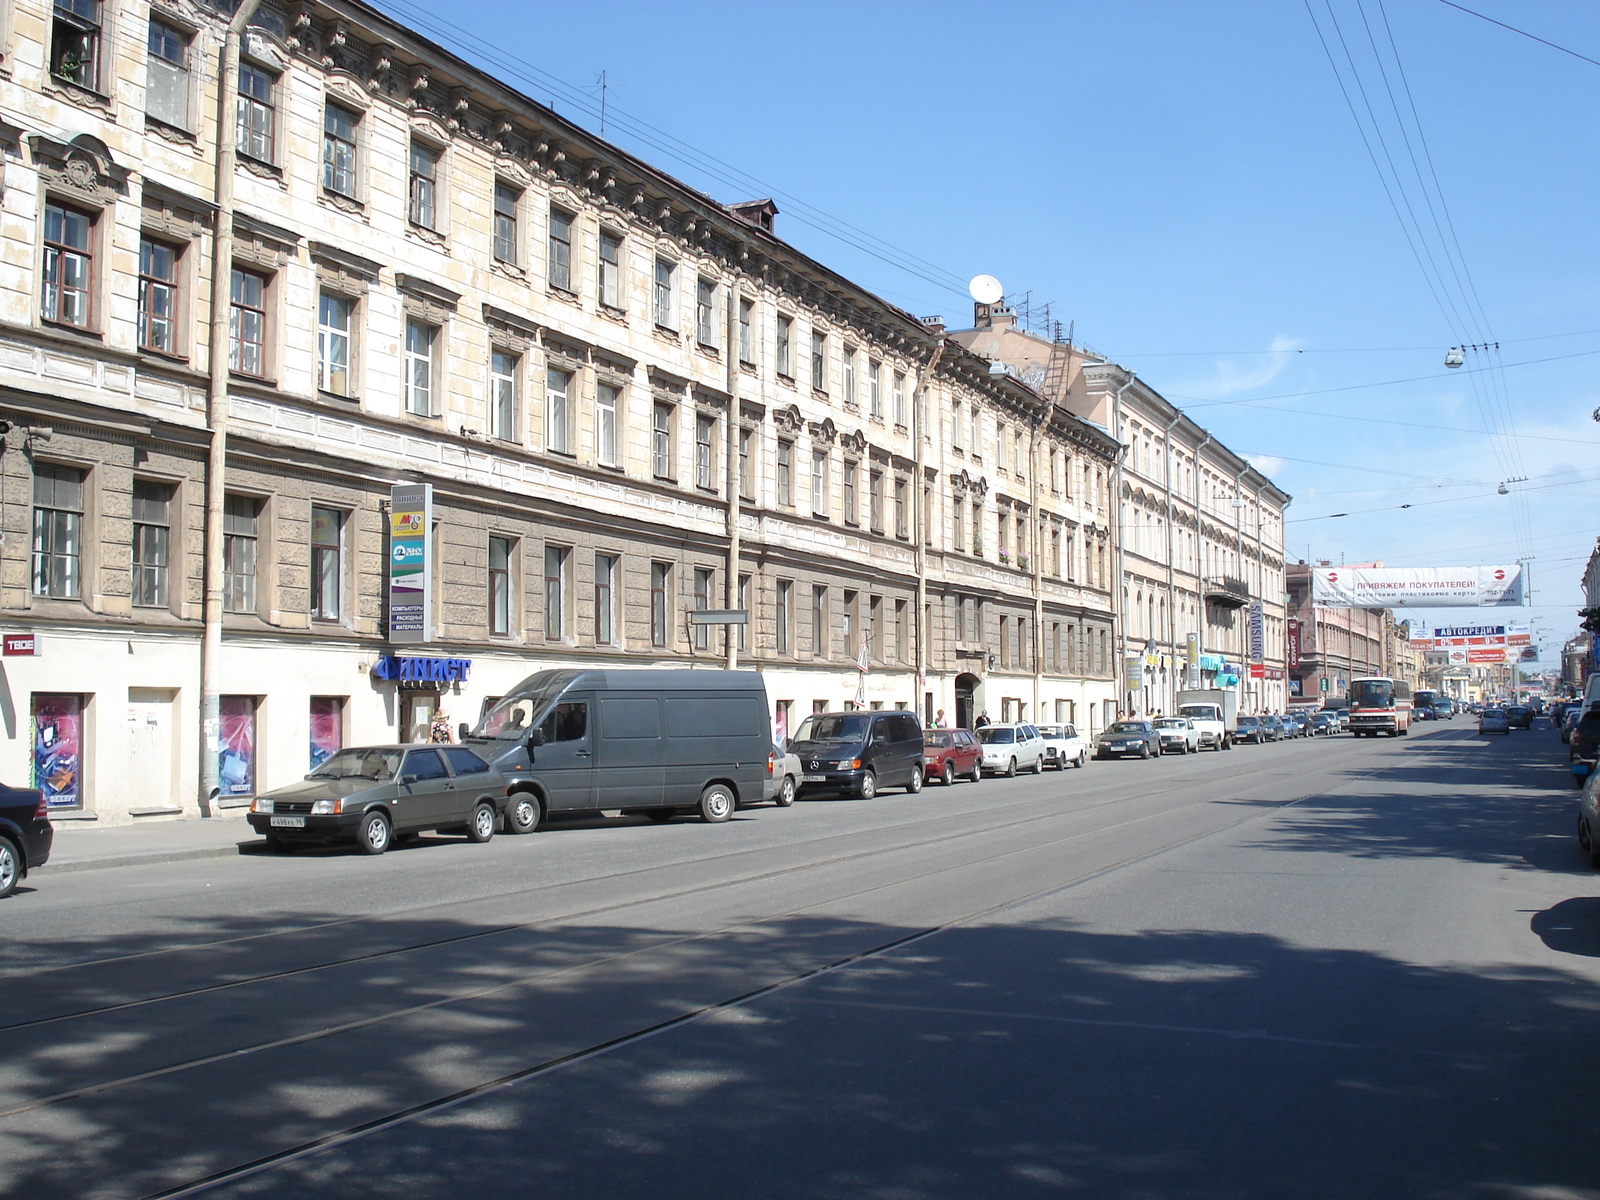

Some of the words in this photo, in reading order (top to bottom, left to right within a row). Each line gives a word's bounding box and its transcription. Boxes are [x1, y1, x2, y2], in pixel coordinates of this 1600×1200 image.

[1357, 582, 1405, 590] ПРИВЯЖЕМ
[1409, 580, 1476, 589] ПОКУПАТЕЛЕЙ!
[1251, 605, 1262, 658] SAMSUNG
[1440, 626, 1498, 636] АВТОКРЕДИТ
[7, 640, 34, 650] ТВОЕ
[1440, 638, 1454, 646] 0%
[375, 656, 471, 682] ФИНИСТ
